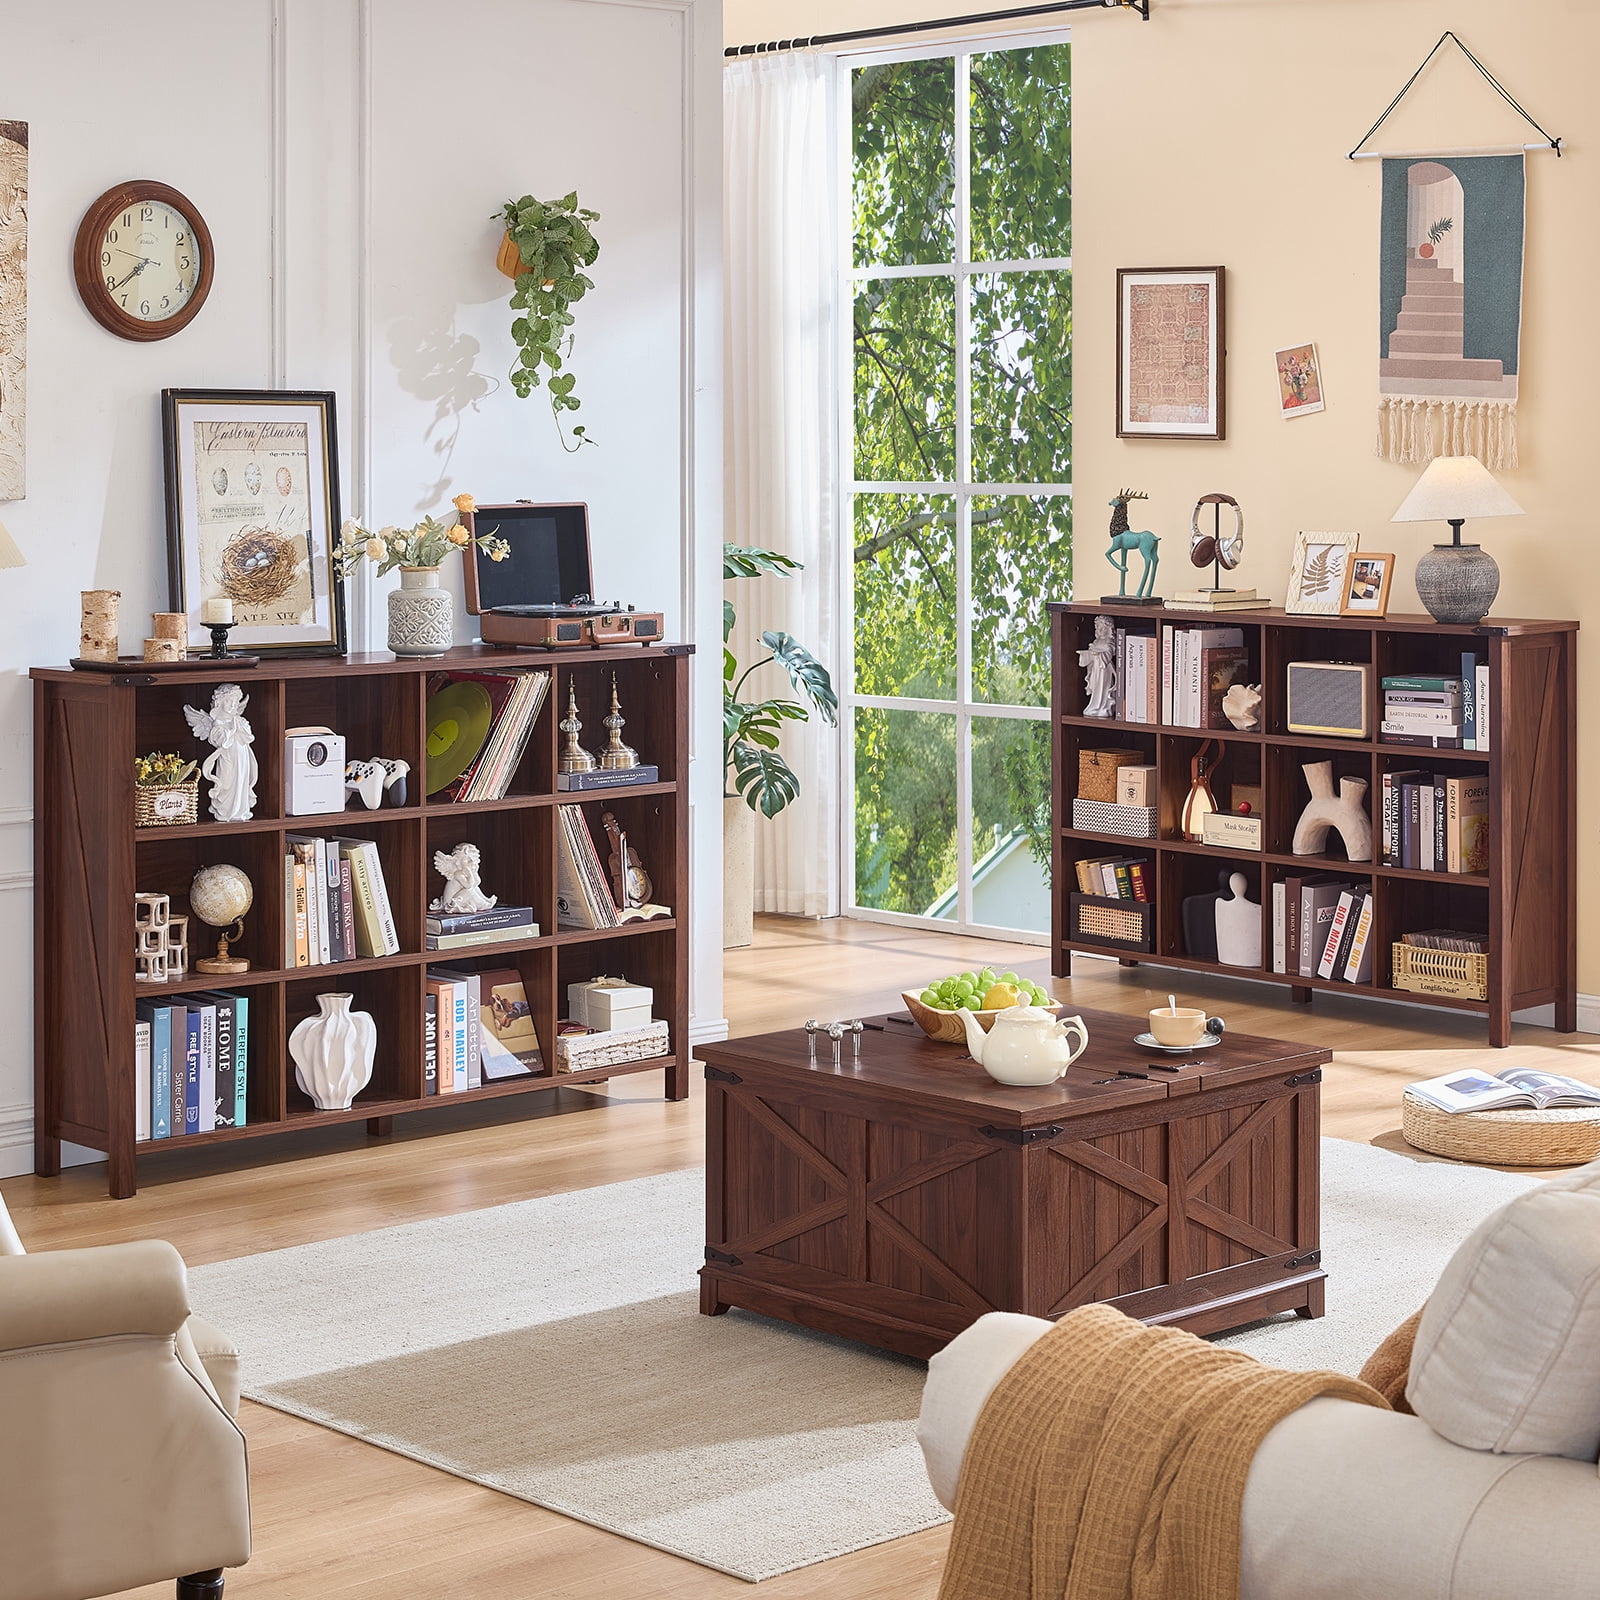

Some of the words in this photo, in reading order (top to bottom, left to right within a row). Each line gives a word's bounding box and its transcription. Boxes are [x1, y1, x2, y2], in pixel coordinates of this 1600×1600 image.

[123, 213, 131, 227] 11
[140, 207, 153, 222] 12
[106, 229, 118, 244] 10
[175, 232, 185, 246] 2
[101, 251, 111, 266] 9
[180, 256, 190, 270] 3
[106, 276, 116, 290] 8
[175, 279, 185, 293] 4
[120, 294, 128, 307] 7
[140, 300, 150, 315] 6
[160, 295, 170, 309] 5
[232, 613, 269, 623] LATE
[1385, 722, 1405, 732] Smile
[1463, 787, 1489, 798] FOREVE
[159, 798, 183, 810] Plants
[1391, 786, 1399, 821] ANNUAL
[1224, 822, 1237, 830] Mask
[1391, 822, 1399, 857] REPORT
[341, 867, 350, 893] GLOW
[358, 860, 366, 880] Kitty
[362, 881, 372, 911] arrives
[296, 887, 304, 913] Sicilian
[1335, 905, 1347, 926] BOB
[1323, 928, 1341, 965] MARLEY
[1349, 949, 1361, 968] BOB
[1356, 909, 1371, 945] MARLEY
[1420, 983, 1442, 992] Longlife
[456, 999, 465, 1023] BOB
[219, 1019, 231, 1072] HOME
[237, 1027, 246, 1074] PERFECT
[425, 1012, 436, 1080] CENTURY
[456, 1029, 465, 1073] MARLEY
[189, 1056, 197, 1083] STYLE
[174, 1072, 183, 1096] Sister
[237, 1076, 245, 1100] SYLE
[174, 1097, 183, 1123] Carrie
